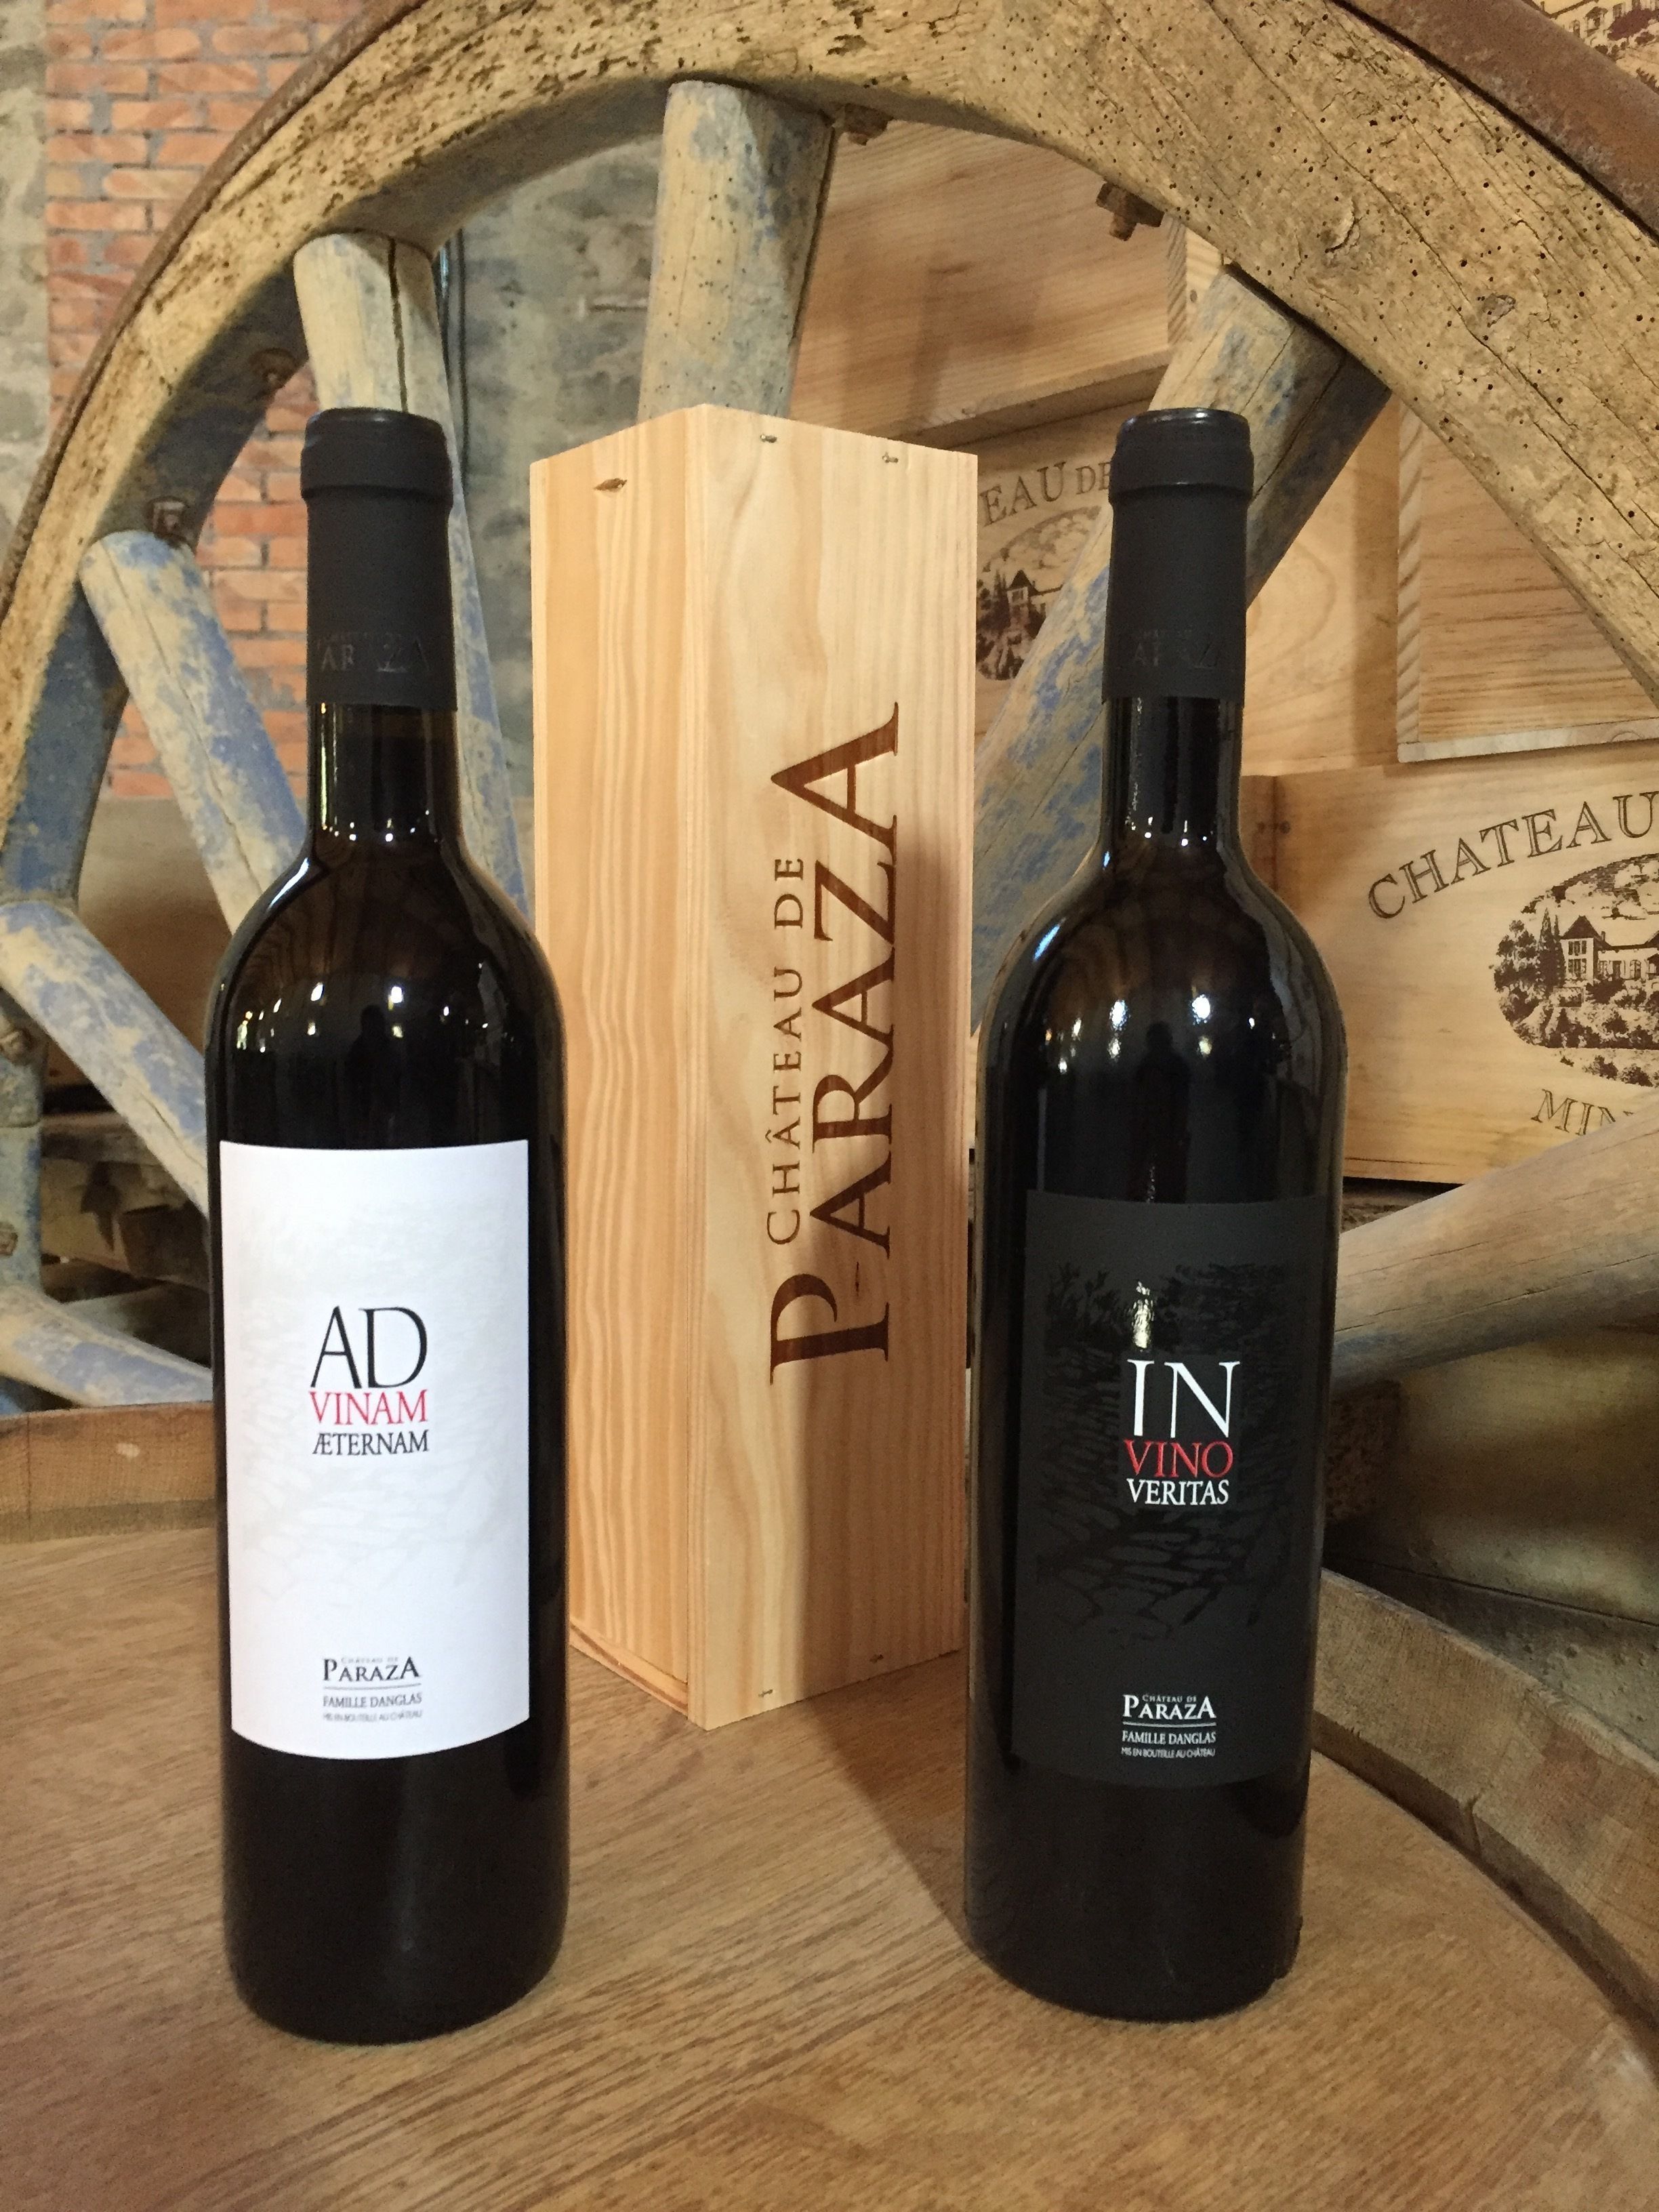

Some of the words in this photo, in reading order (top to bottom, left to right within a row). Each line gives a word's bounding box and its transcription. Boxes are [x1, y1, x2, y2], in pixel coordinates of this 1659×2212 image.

[1368, 792, 1659, 920] CHATEAU
[773, 857, 804, 930] DE
[769, 701, 899, 1385] PARAZA
[766, 967, 804, 1246] CHÂTEAU
[310, 1305, 428, 1389] AD
[308, 1389, 429, 1426] VINAM
[1127, 1358, 1241, 1438] IN
[312, 1429, 430, 1456] ÆTERNAM
[1124, 1438, 1234, 1479] VINO
[1126, 1477, 1230, 1506] VERITAS
[323, 1656, 422, 1682] PARAZA
[323, 1696, 367, 1708] FAMILLE
[370, 1692, 423, 1708] DANGLAS
[1122, 1694, 1217, 1720] PARAZA
[1122, 1729, 1166, 1745] FAMILLE
[1168, 1731, 1217, 1745] DANGLAS
